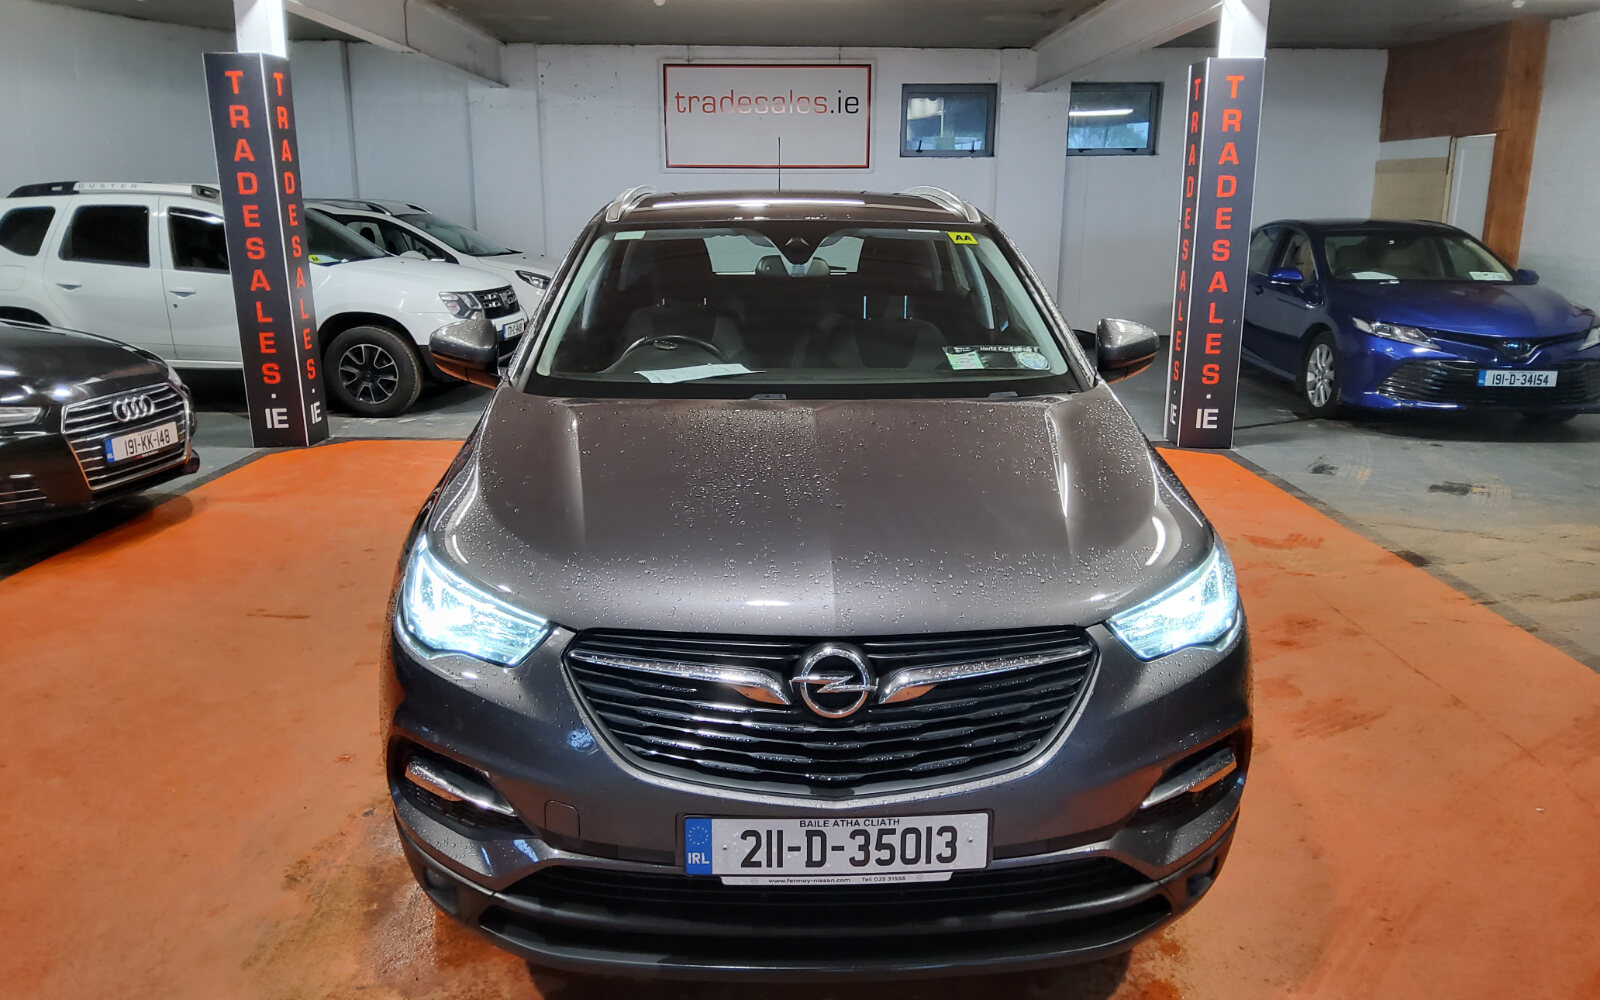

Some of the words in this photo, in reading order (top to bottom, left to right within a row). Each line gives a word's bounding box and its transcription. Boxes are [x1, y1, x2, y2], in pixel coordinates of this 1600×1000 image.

[674, 89, 859, 114] tradesales.ie
[955, 234, 973, 242] AA
[1491, 373, 1549, 386] 191-D-34154
[124, 428, 171, 456] 191-KK-148
[799, 820, 829, 828] BAILE
[863, 818, 900, 827] CLIATH
[740, 825, 958, 868] 211-D-35013
[687, 852, 710, 865] IRL
